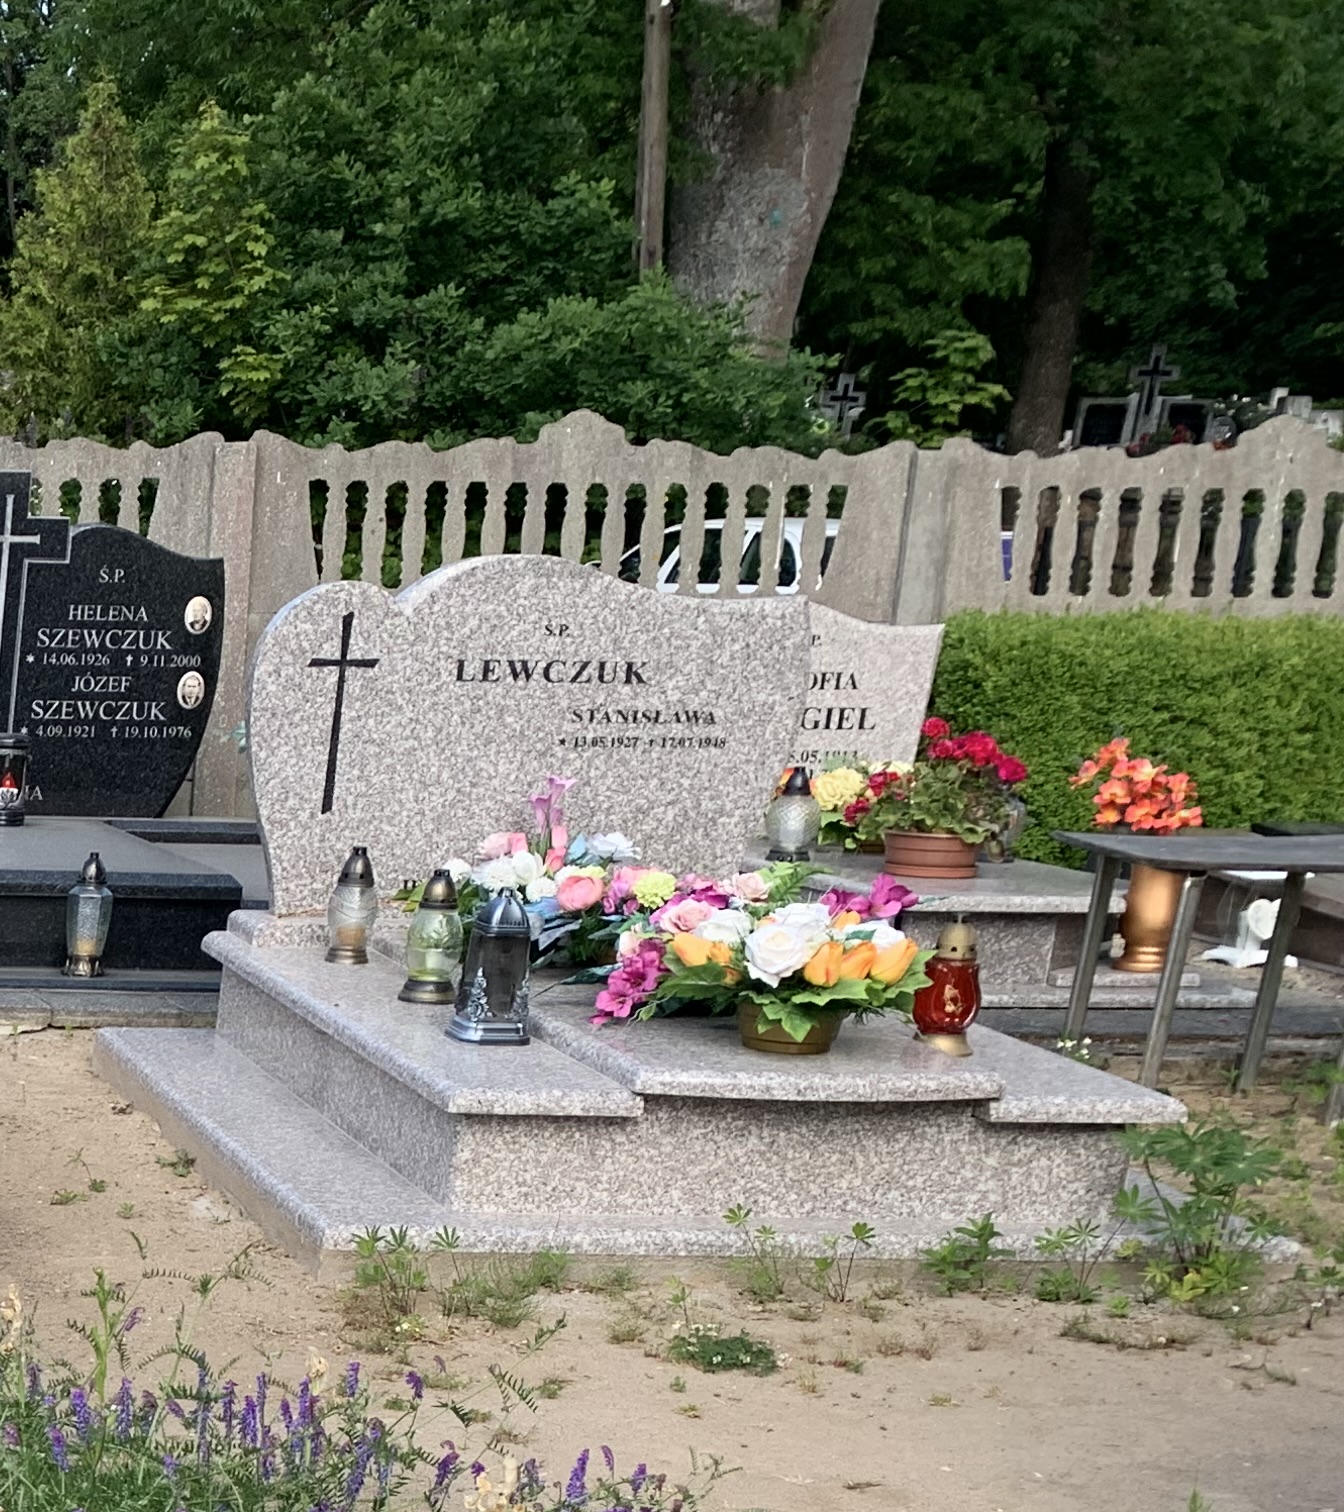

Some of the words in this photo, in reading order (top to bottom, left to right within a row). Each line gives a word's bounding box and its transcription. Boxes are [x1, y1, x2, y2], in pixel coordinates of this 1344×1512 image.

[68, 604, 149, 622] HELENA
[36, 628, 172, 650] SZEWCZUK
[42, 653, 111, 667] 14.06.1926
[140, 654, 201, 668] 9.11.2000
[455, 659, 649, 685] LEWCZUK
[70, 671, 132, 693] JÓZEF
[31, 700, 167, 721] SZEWCZUK
[35, 725, 95, 738] 4.09.1921
[125, 725, 192, 739] 19.10.1976
[573, 736, 639, 749] 13.05.1927
